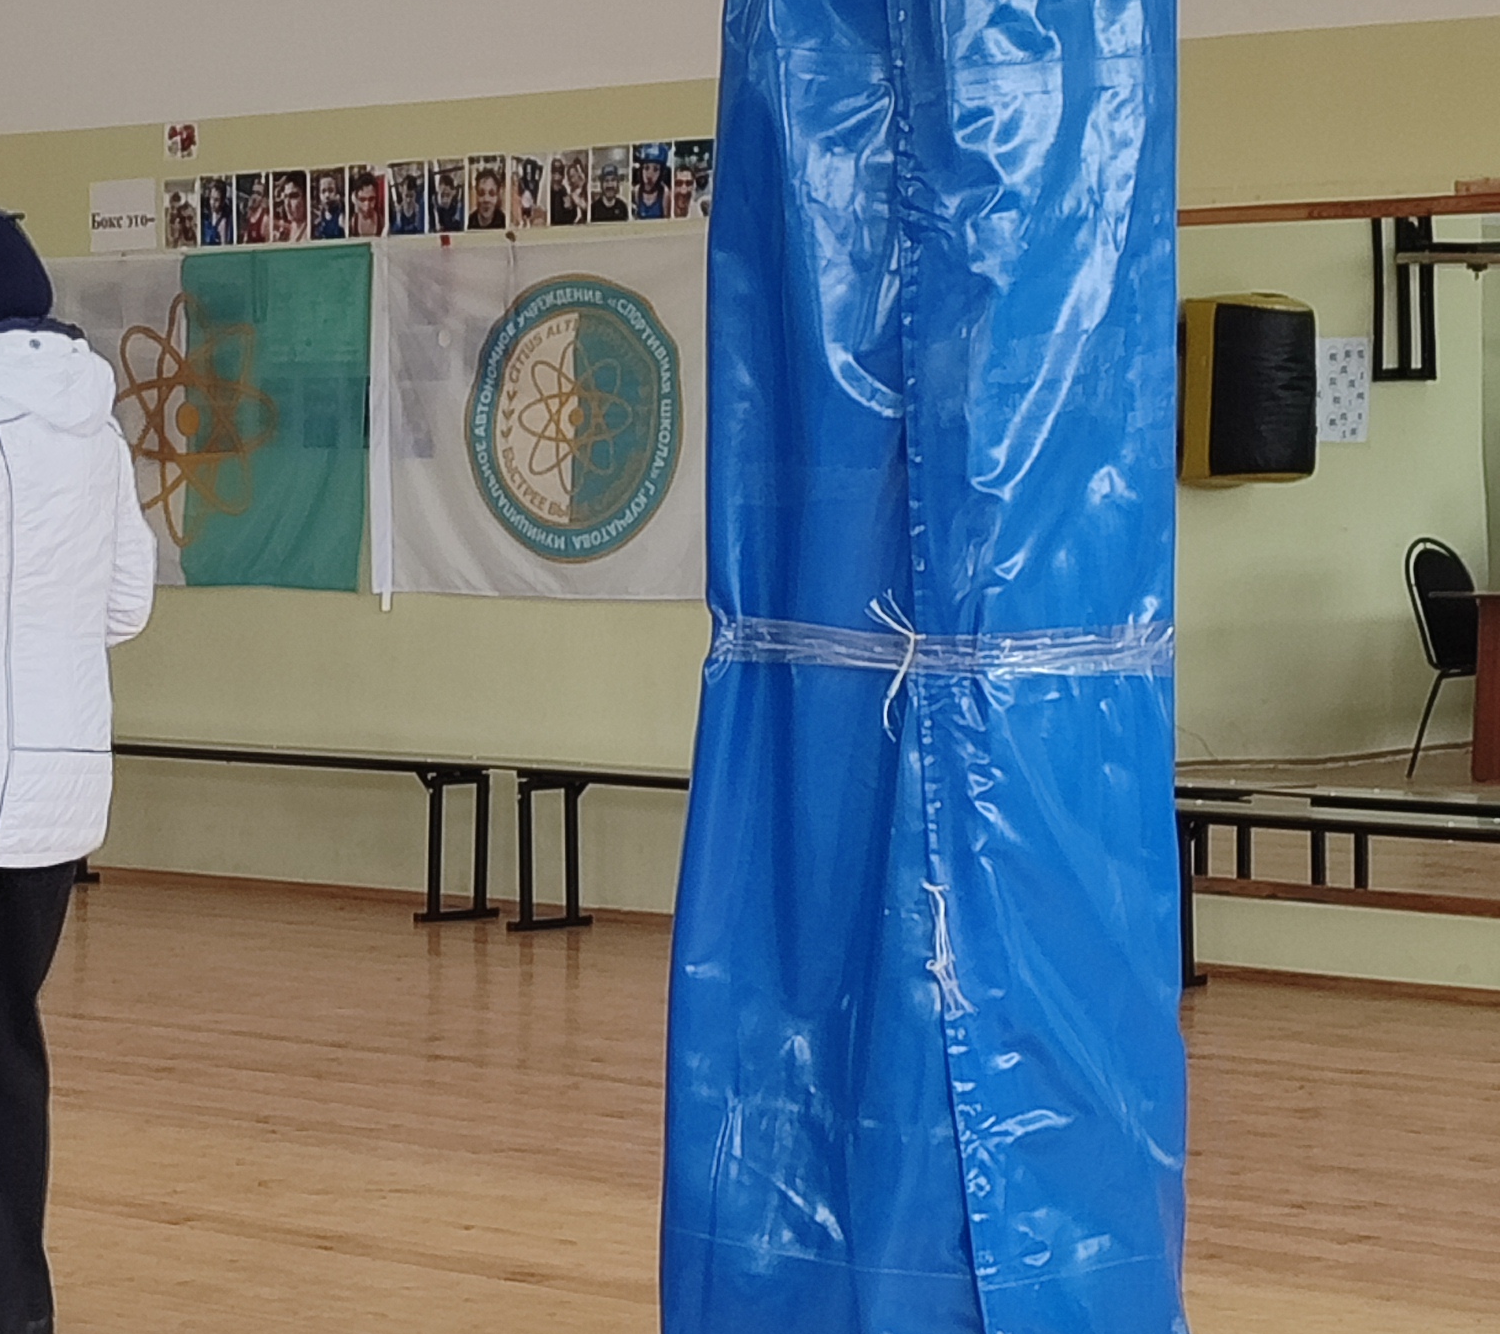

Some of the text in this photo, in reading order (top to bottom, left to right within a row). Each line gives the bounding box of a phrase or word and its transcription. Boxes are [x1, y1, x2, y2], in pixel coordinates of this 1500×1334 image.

[91, 212, 124, 230] Бокс
[517, 287, 604, 328] УЧРЕЖДЕНИЕ
[474, 319, 518, 438] АВТОНОМНОЕ
[508, 334, 544, 384] CITIUS
[474, 440, 566, 550] МУНИЦИПАЛЬНОЕ
